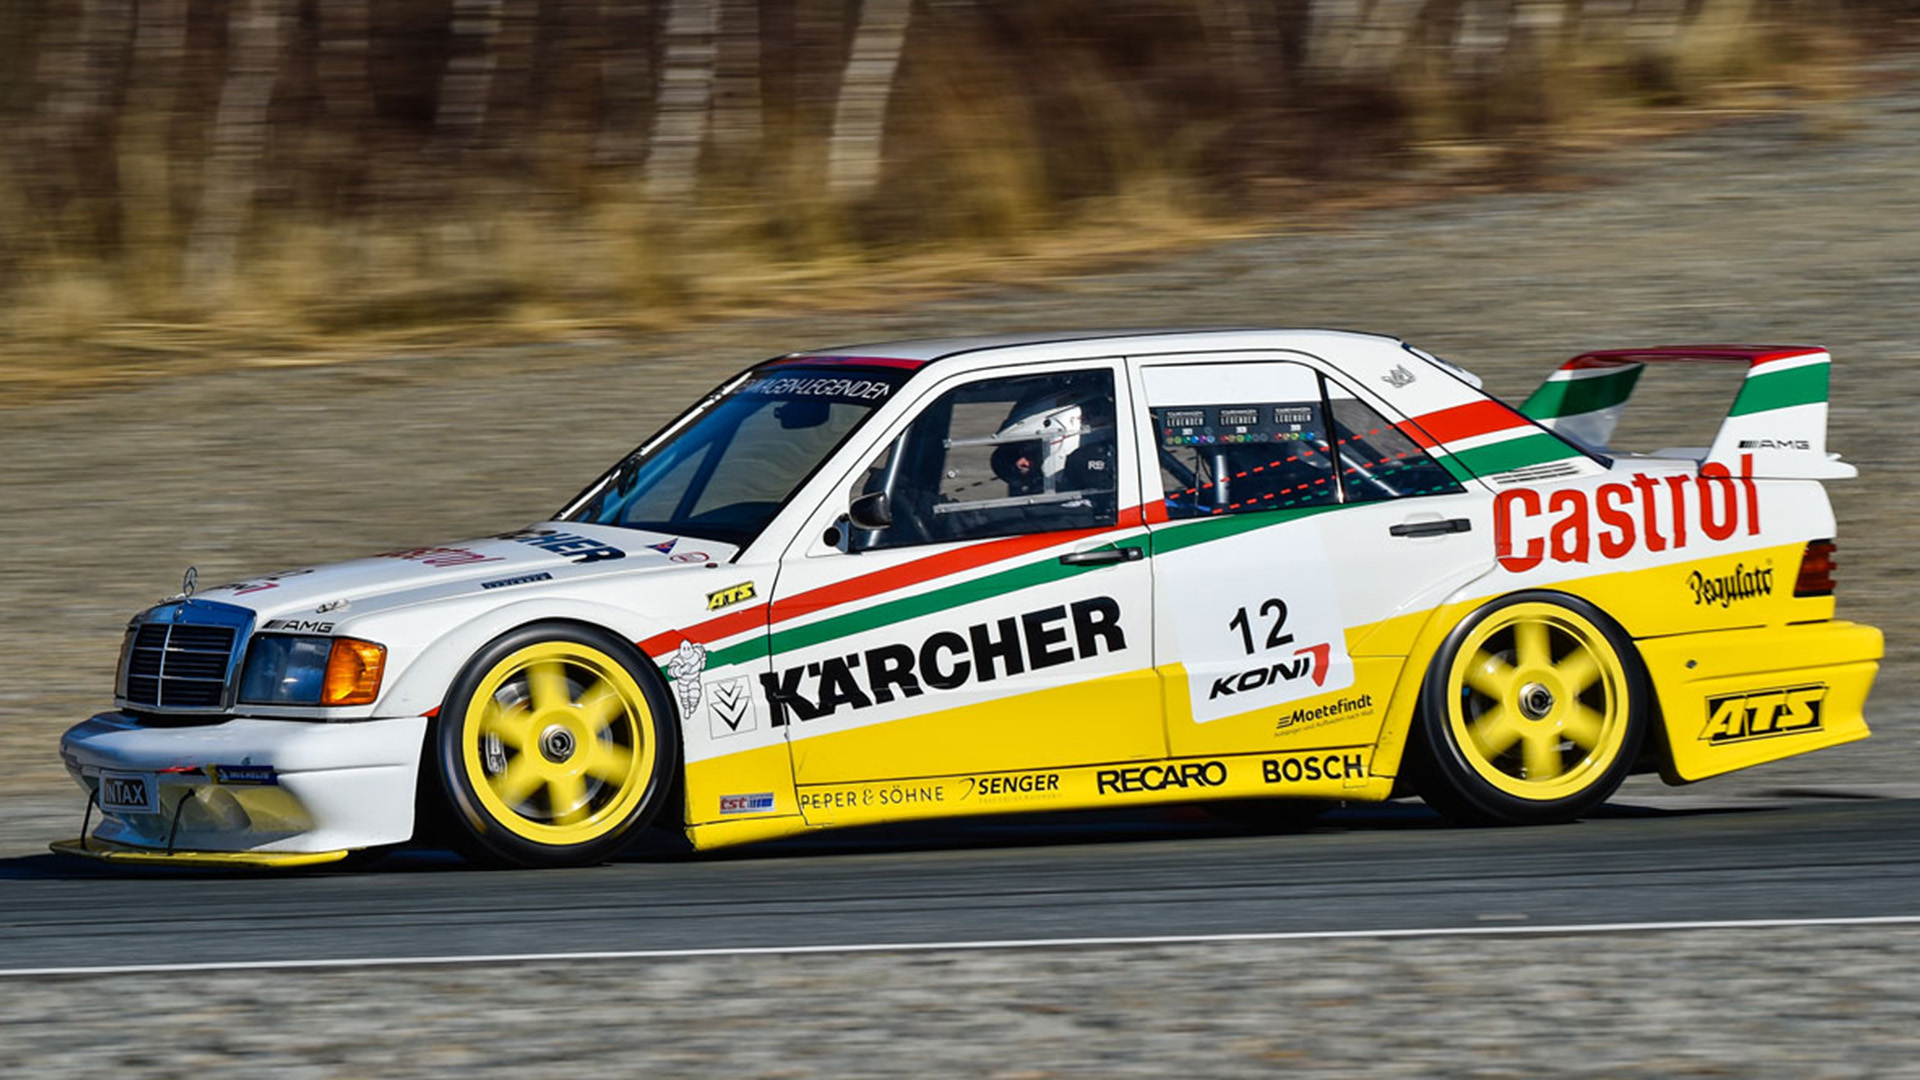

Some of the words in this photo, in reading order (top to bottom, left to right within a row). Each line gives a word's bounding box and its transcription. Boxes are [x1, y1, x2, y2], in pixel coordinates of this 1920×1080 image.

[1759, 439, 1810, 450] AMG
[1493, 453, 1760, 573] Castrol
[708, 582, 754, 610] ATS
[282, 620, 336, 634] AMG
[1229, 598, 1295, 655] 12
[759, 596, 1128, 729] KÄRCHER
[1209, 657, 1310, 700] KONI
[1289, 694, 1373, 725] Moetefindt
[1698, 688, 1828, 740] ATS
[1097, 760, 1228, 794] RECARO
[1263, 754, 1363, 783] BOSCH
[801, 791, 857, 810] PEPER
[864, 788, 874, 805] &
[880, 785, 945, 805] SÖHNE
[978, 774, 1060, 795] SENGER
